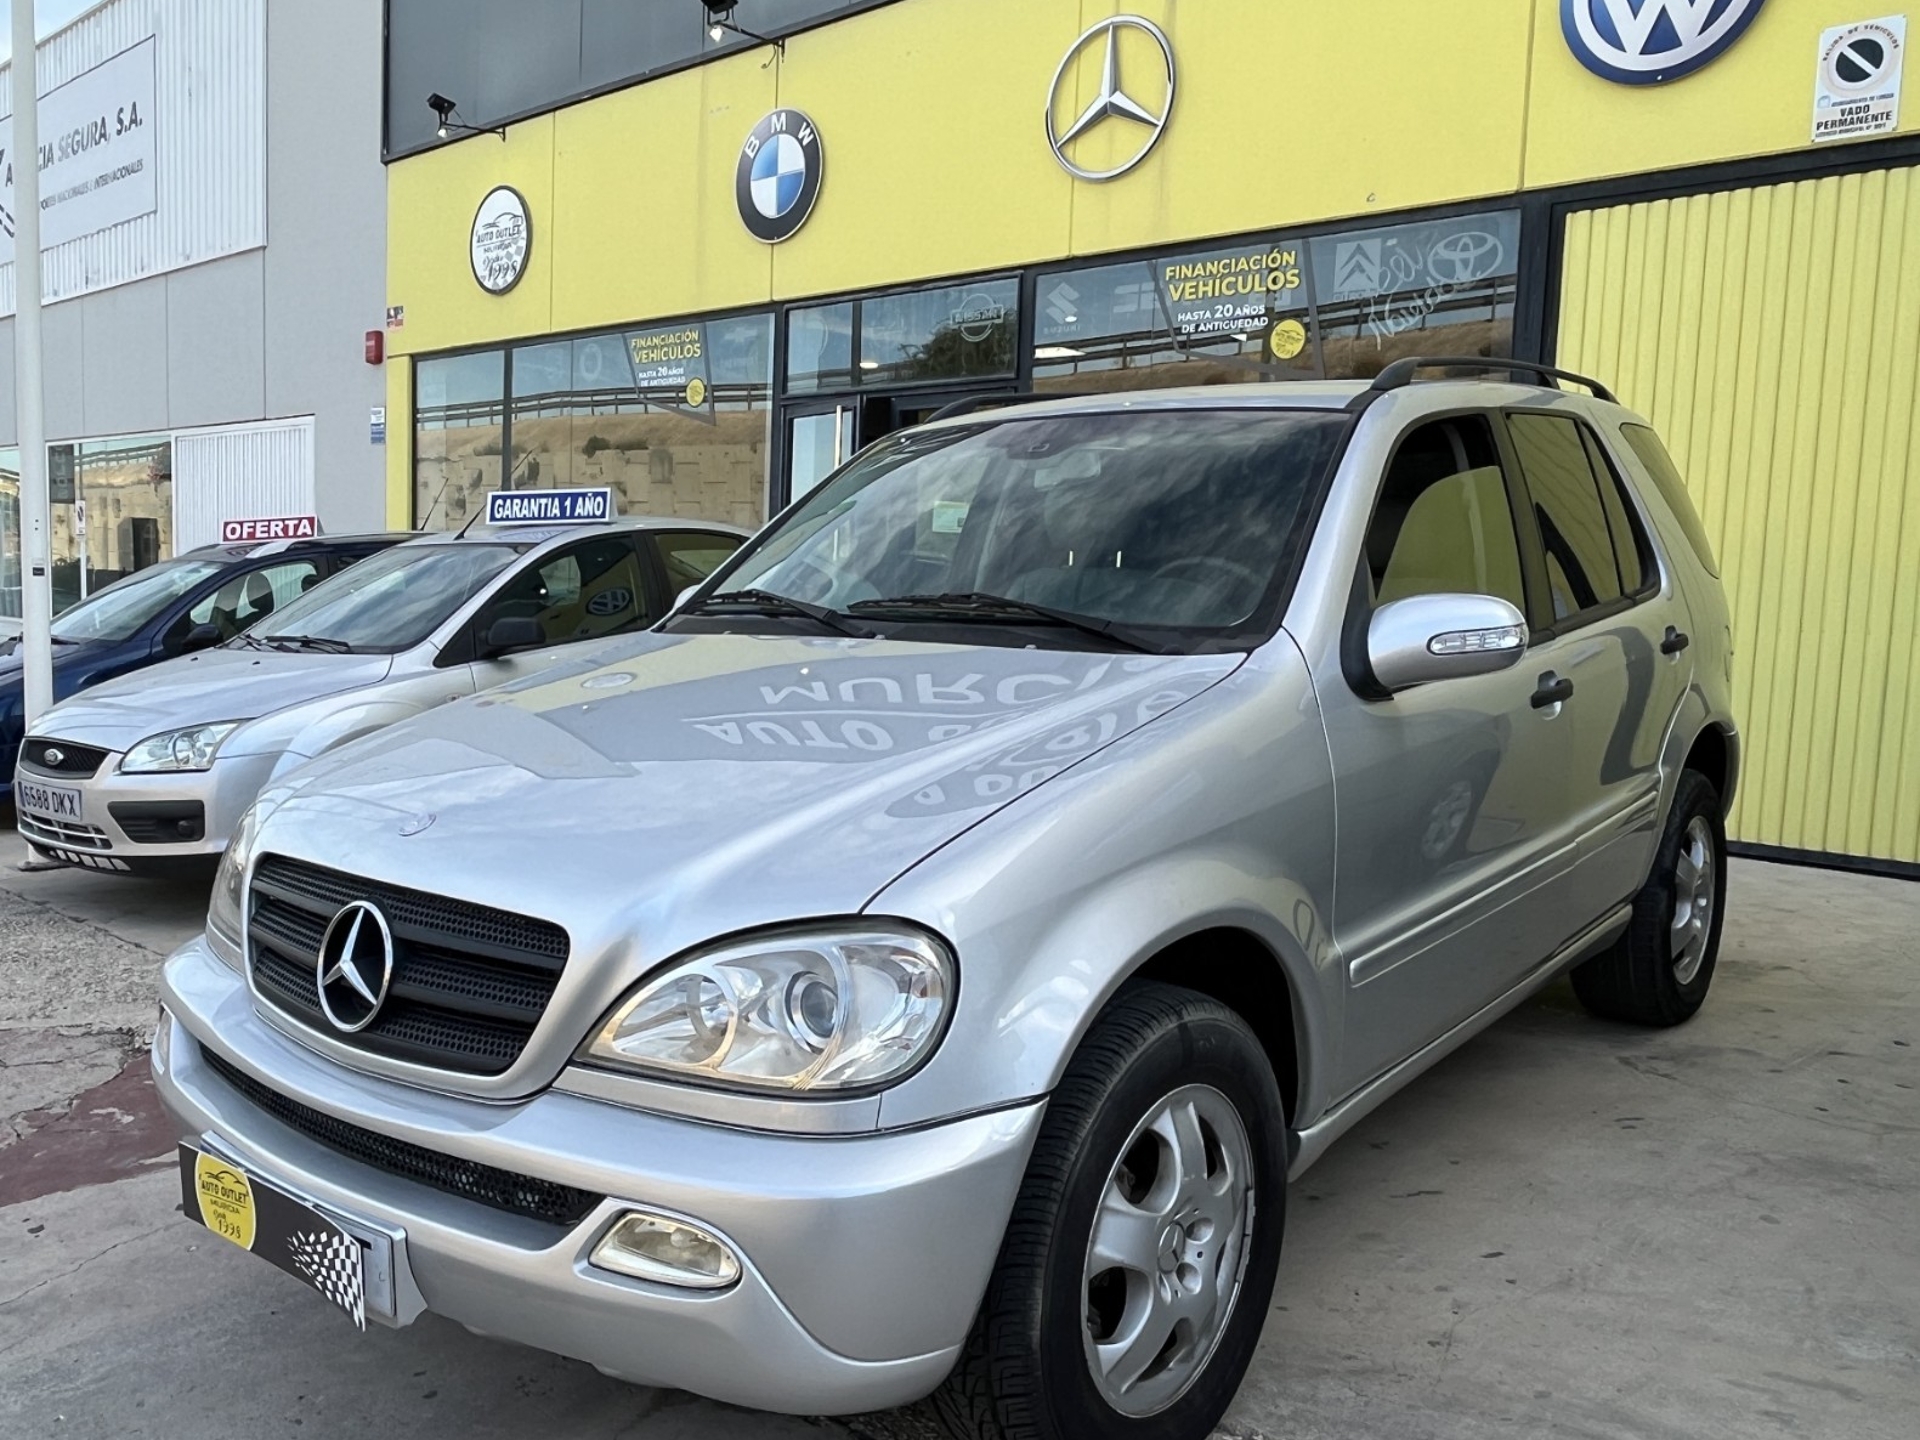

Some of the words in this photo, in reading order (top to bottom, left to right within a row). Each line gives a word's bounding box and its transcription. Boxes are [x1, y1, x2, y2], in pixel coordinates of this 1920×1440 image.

[116, 101, 143, 136] S.A.
[1816, 110, 1892, 131] PERMANENTE
[1840, 104, 1870, 118] VADO
[744, 112, 814, 159] BMW
[477, 231, 494, 243] AUTO
[495, 225, 521, 239] OUTLET
[488, 259, 518, 282] 1998
[1165, 248, 1296, 281] FINANCIACIÓN
[1168, 268, 1301, 302] VEHÍCULOS
[955, 306, 1000, 323] NISSAN
[1178, 309, 1212, 322] HASTA
[1213, 304, 1234, 318] 20
[1234, 304, 1266, 316] AÑOS
[631, 329, 699, 348] FINANCIACIÓN
[1181, 323, 1196, 334] DE
[633, 343, 702, 364] VEHÍCULOS
[657, 366, 668, 377] 20
[494, 497, 560, 519] GARANTIA
[564, 497, 571, 517] 1
[575, 493, 604, 517] AÑO
[225, 518, 314, 541] OFERTA
[23, 784, 50, 811] 6588
[52, 791, 77, 817] DKX
[201, 1179, 220, 1195] AUTO
[220, 1186, 247, 1205] OUTLET
